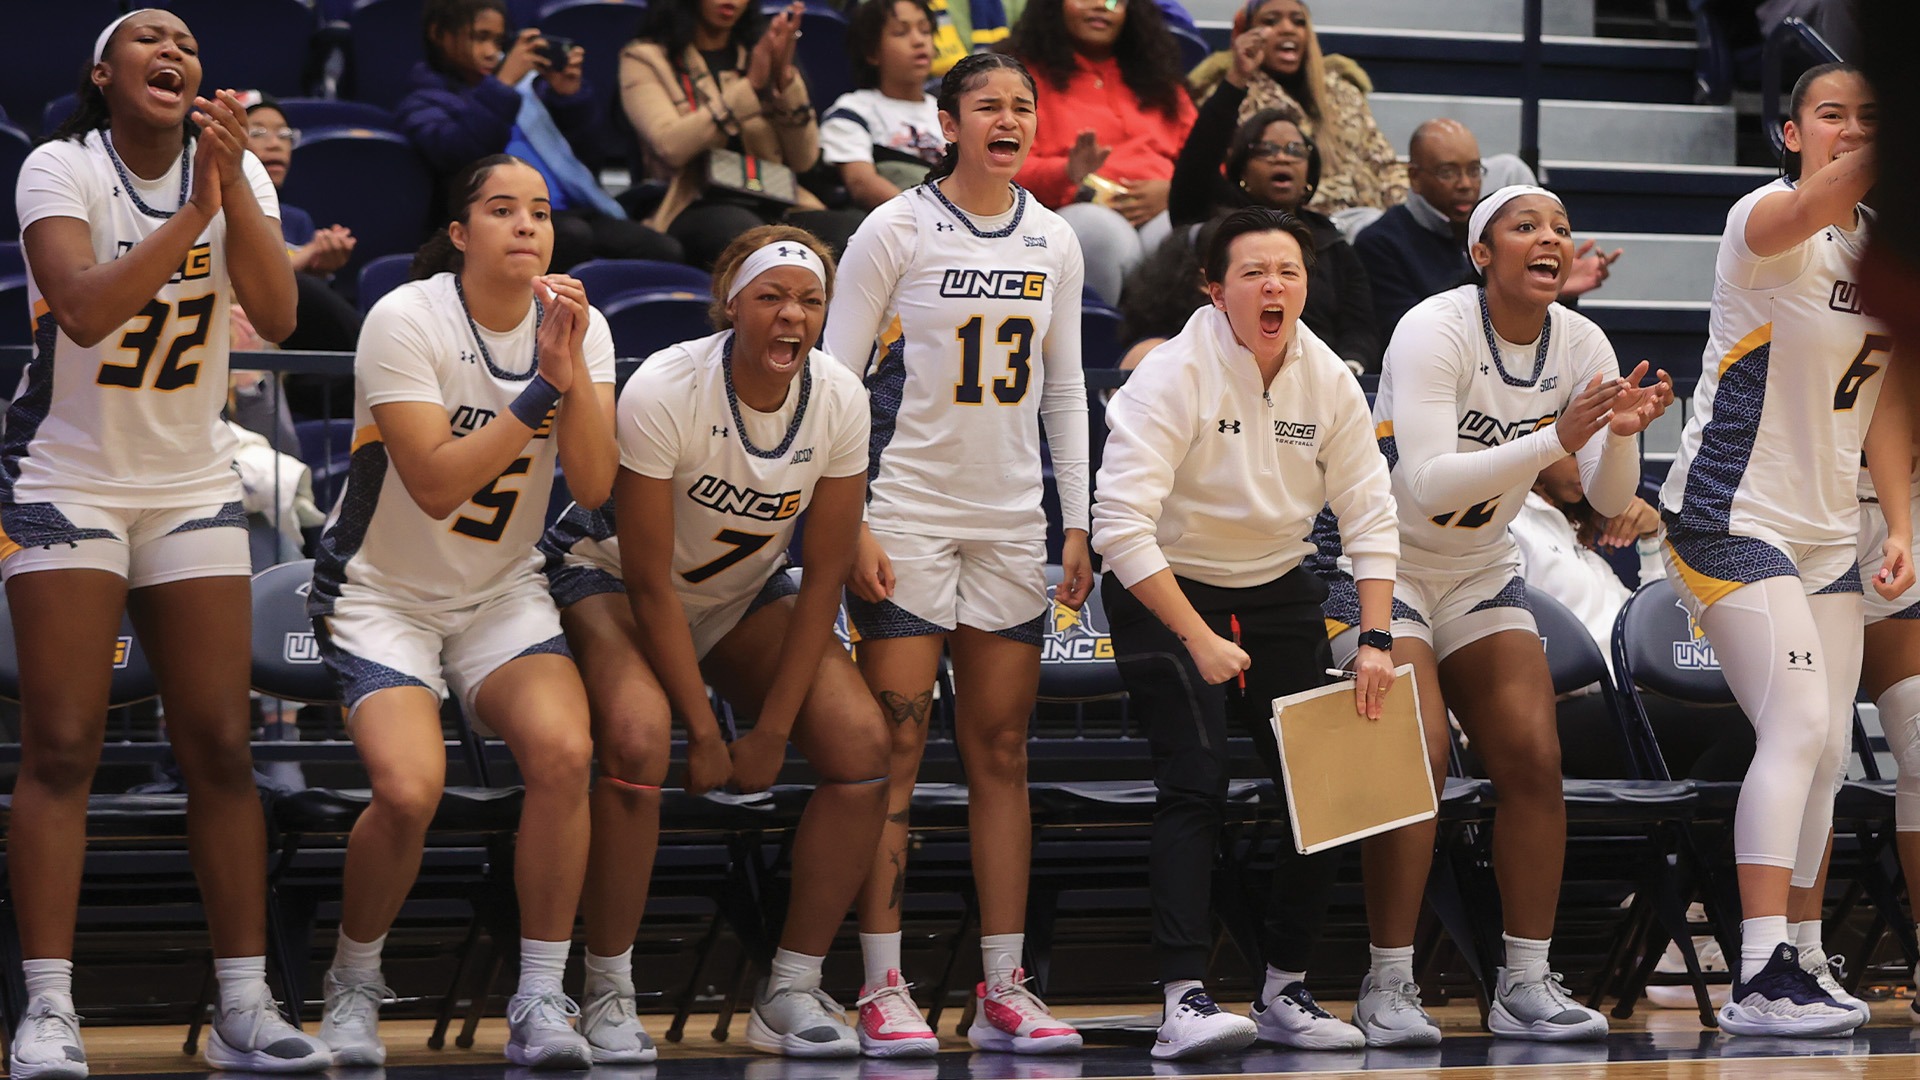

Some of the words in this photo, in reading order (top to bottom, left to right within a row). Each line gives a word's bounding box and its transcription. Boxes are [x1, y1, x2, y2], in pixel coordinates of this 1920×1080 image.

[940, 269, 1047, 301] UNCG
[95, 291, 217, 393] 32
[953, 313, 1037, 407] 13
[1832, 330, 1894, 413] 6
[1275, 438, 1314, 447] SKETBALL
[448, 455, 535, 545] 5
[687, 474, 802, 522] UNCG
[678, 526, 779, 585] 7
[1673, 641, 1722, 670] UN
